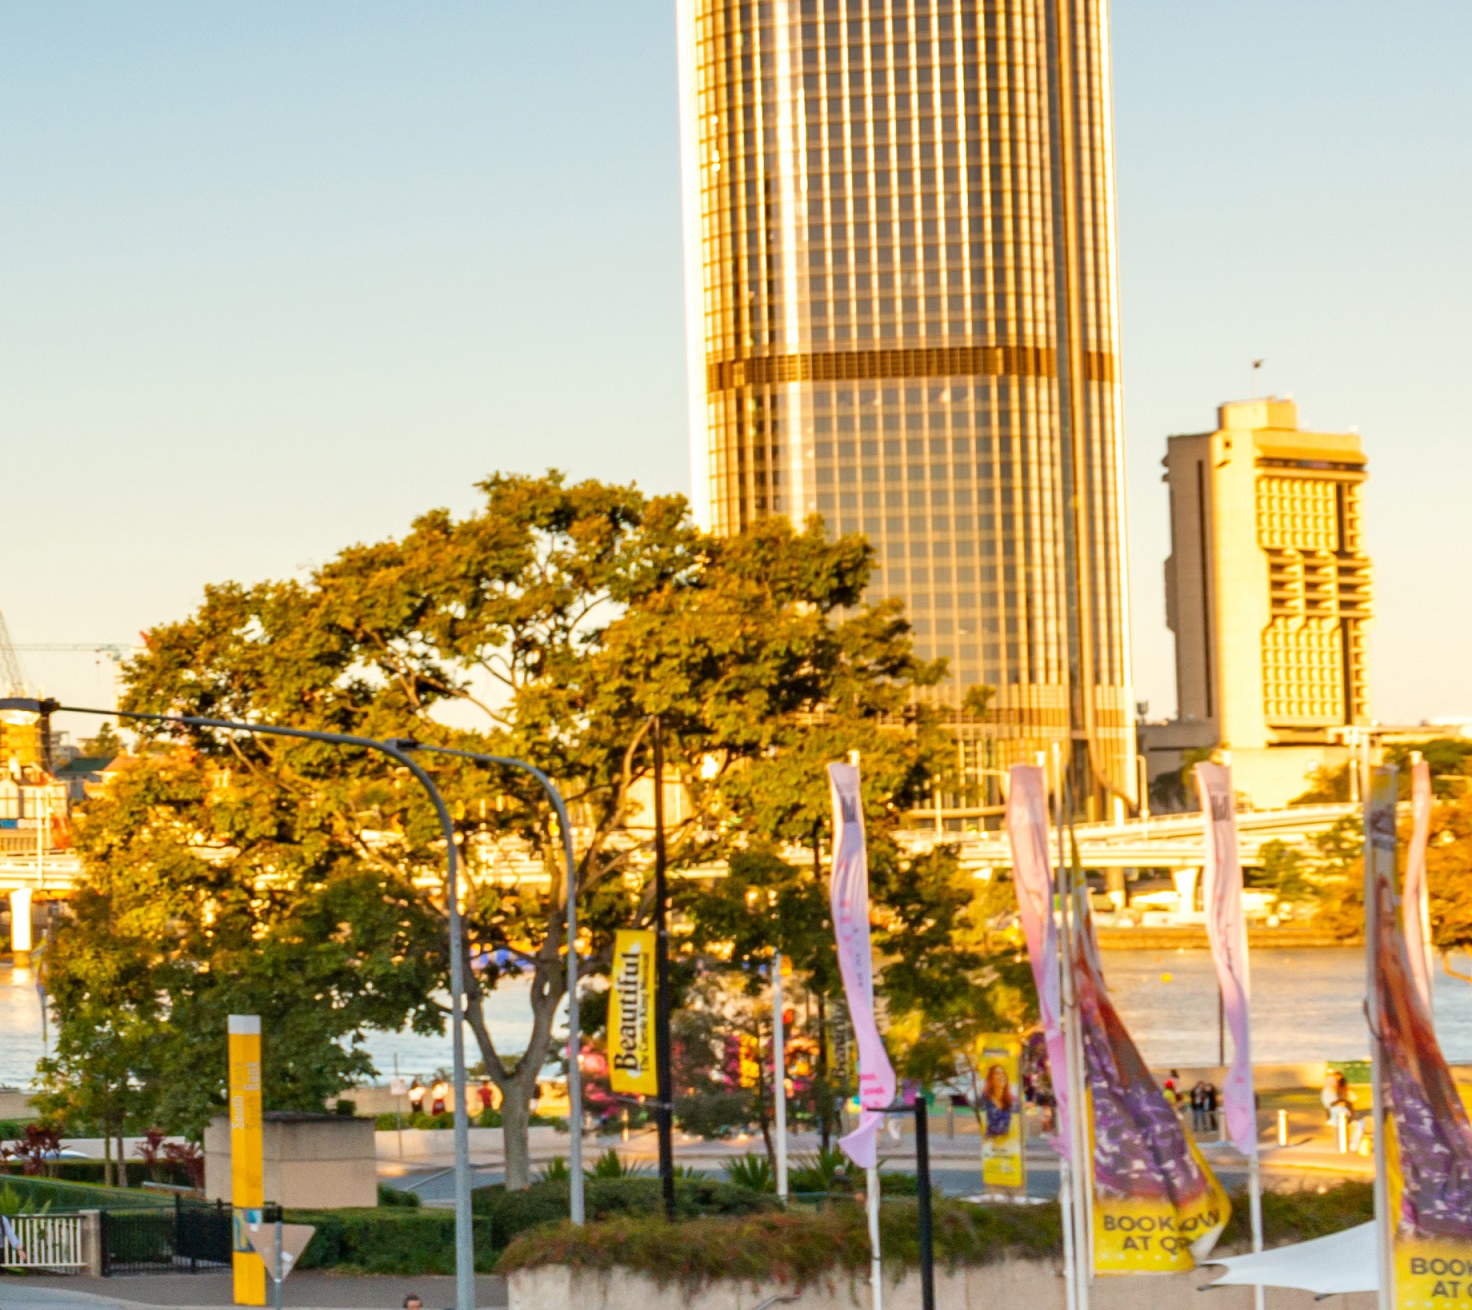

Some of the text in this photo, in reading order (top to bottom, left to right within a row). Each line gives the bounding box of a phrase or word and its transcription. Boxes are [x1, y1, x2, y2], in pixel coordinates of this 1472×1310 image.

[614, 952, 642, 1072] Beautiful
[1104, 1215, 1175, 1232] BOOK
[1123, 1235, 1151, 1251] AT
[1432, 1282, 1460, 1298] AT
